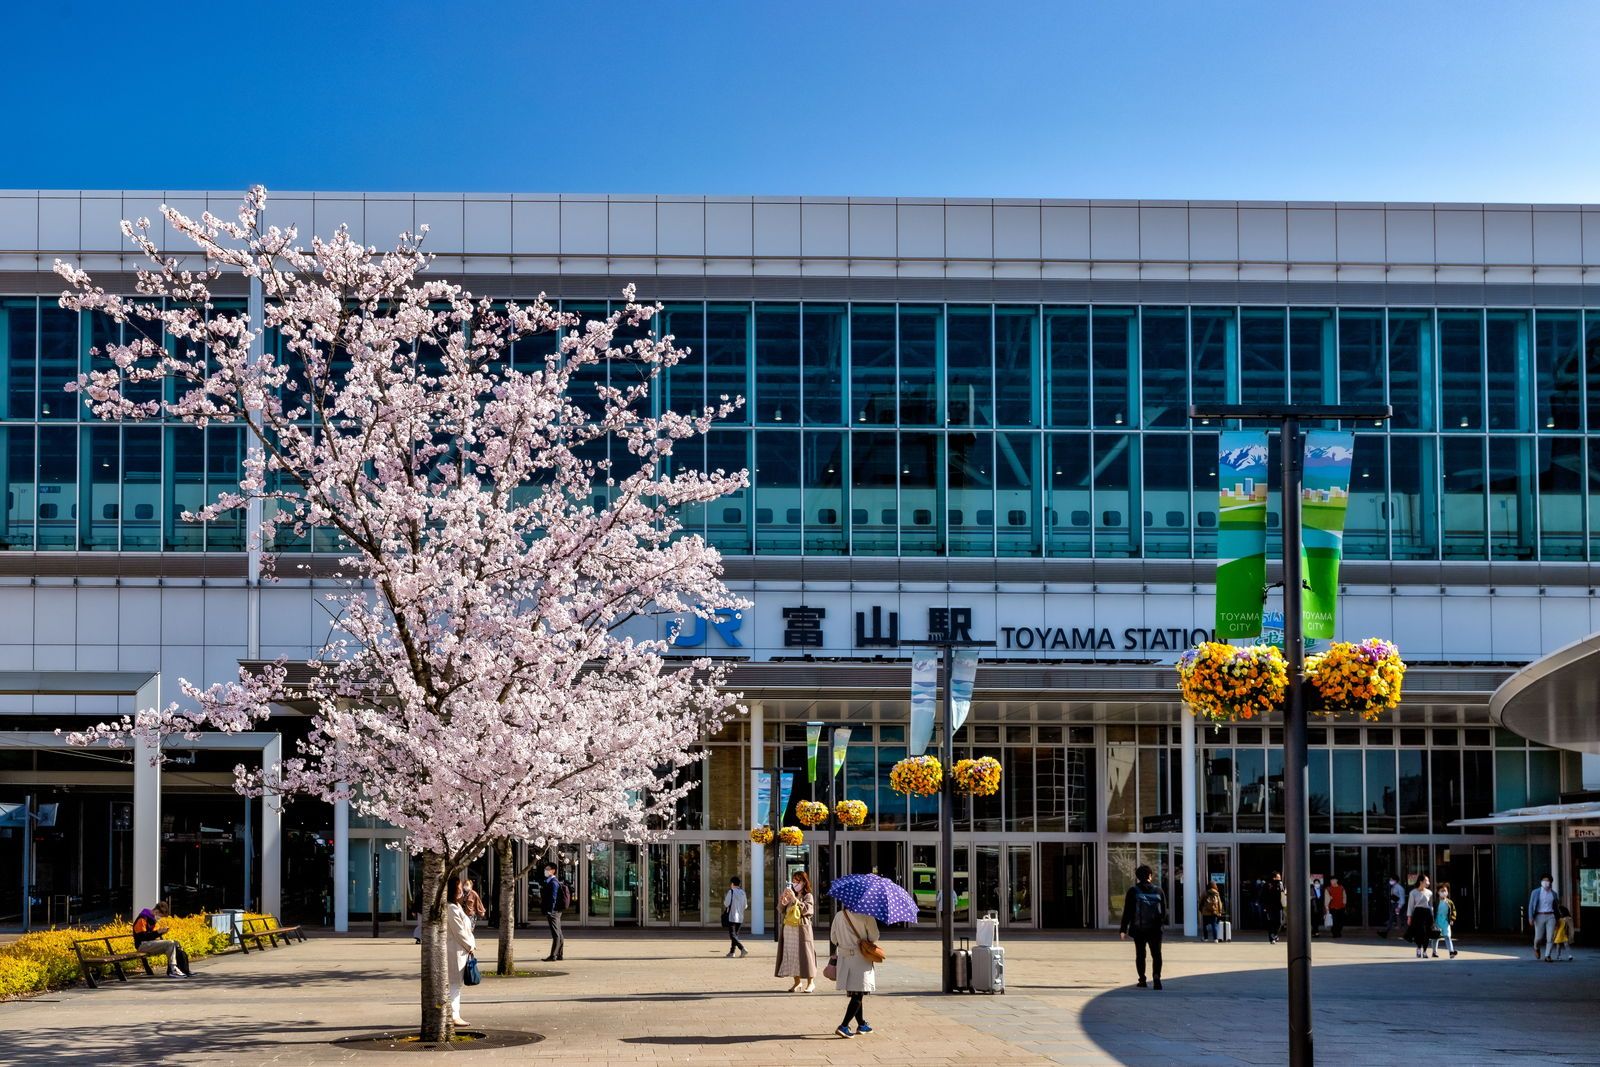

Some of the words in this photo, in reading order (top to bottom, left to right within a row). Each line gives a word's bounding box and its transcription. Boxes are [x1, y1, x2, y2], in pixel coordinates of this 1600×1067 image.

[1220, 612, 1260, 621] TOYAMA
[1302, 610, 1332, 620] TOYAMA
[666, 604, 743, 647] JR
[783, 605, 973, 647] 富山駅
[1001, 627, 1115, 649] TOYAMA
[1229, 623, 1251, 632] CITY
[1307, 622, 1325, 630] CITY
